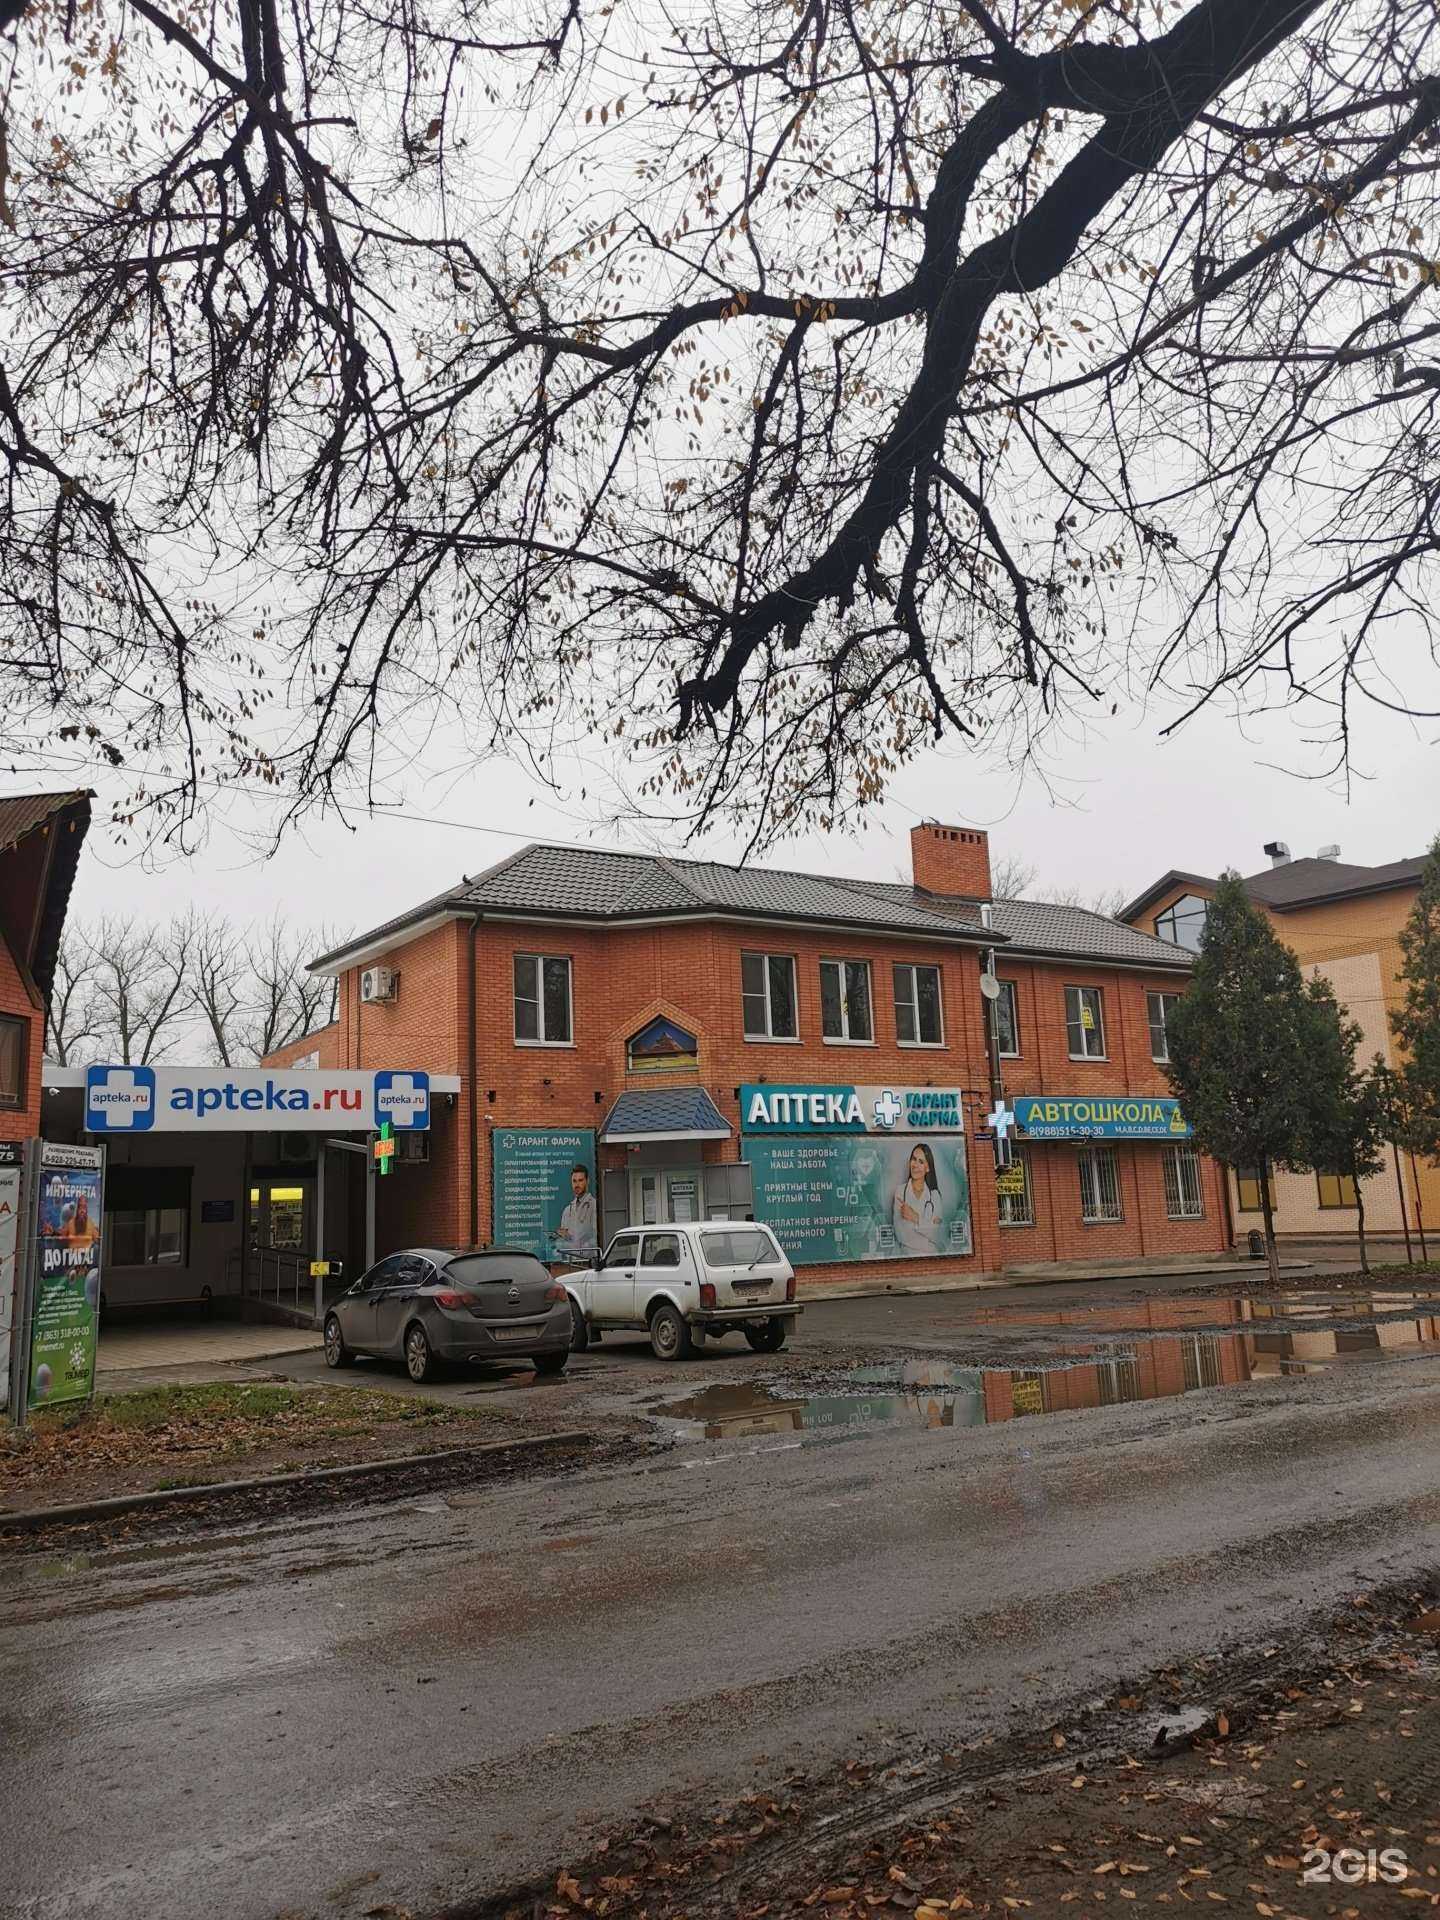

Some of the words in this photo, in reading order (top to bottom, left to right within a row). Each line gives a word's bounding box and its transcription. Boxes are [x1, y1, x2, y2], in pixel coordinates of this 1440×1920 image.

[93, 1092, 147, 1104] apteka.ru
[170, 1081, 362, 1117] apteka.ru
[380, 1095, 424, 1105] apteka.ru
[905, 1092, 960, 1108] ГАРАНТ
[748, 1092, 865, 1124] АПТЕКА
[1028, 1103, 1165, 1122] АВТОШКОЛА
[908, 1110, 960, 1126] ФАРМА
[518, 1137, 548, 1146] ГАРАНТ
[551, 1137, 582, 1146] ФАРМА
[772, 1149, 795, 1158] ВАШЕ
[798, 1148, 839, 1159] ЗДОРОВЬЕ
[770, 1160, 794, 1169] НАША
[797, 1160, 827, 1169] ЗАБОТА
[45, 1183, 96, 1199] ИНТЕРНЕТА
[764, 1182, 808, 1192] ПРИЯТНЫЕ
[810, 1182, 833, 1191] ЦЕНЫ
[766, 1193, 803, 1203] КРУГЛЫЙ
[806, 1193, 822, 1203] ГОД
[813, 1215, 859, 1225] ИЗМЕРЕНИЕ
[44, 1248, 62, 1271] ДО
[62, 1247, 94, 1266] ГИГА!
